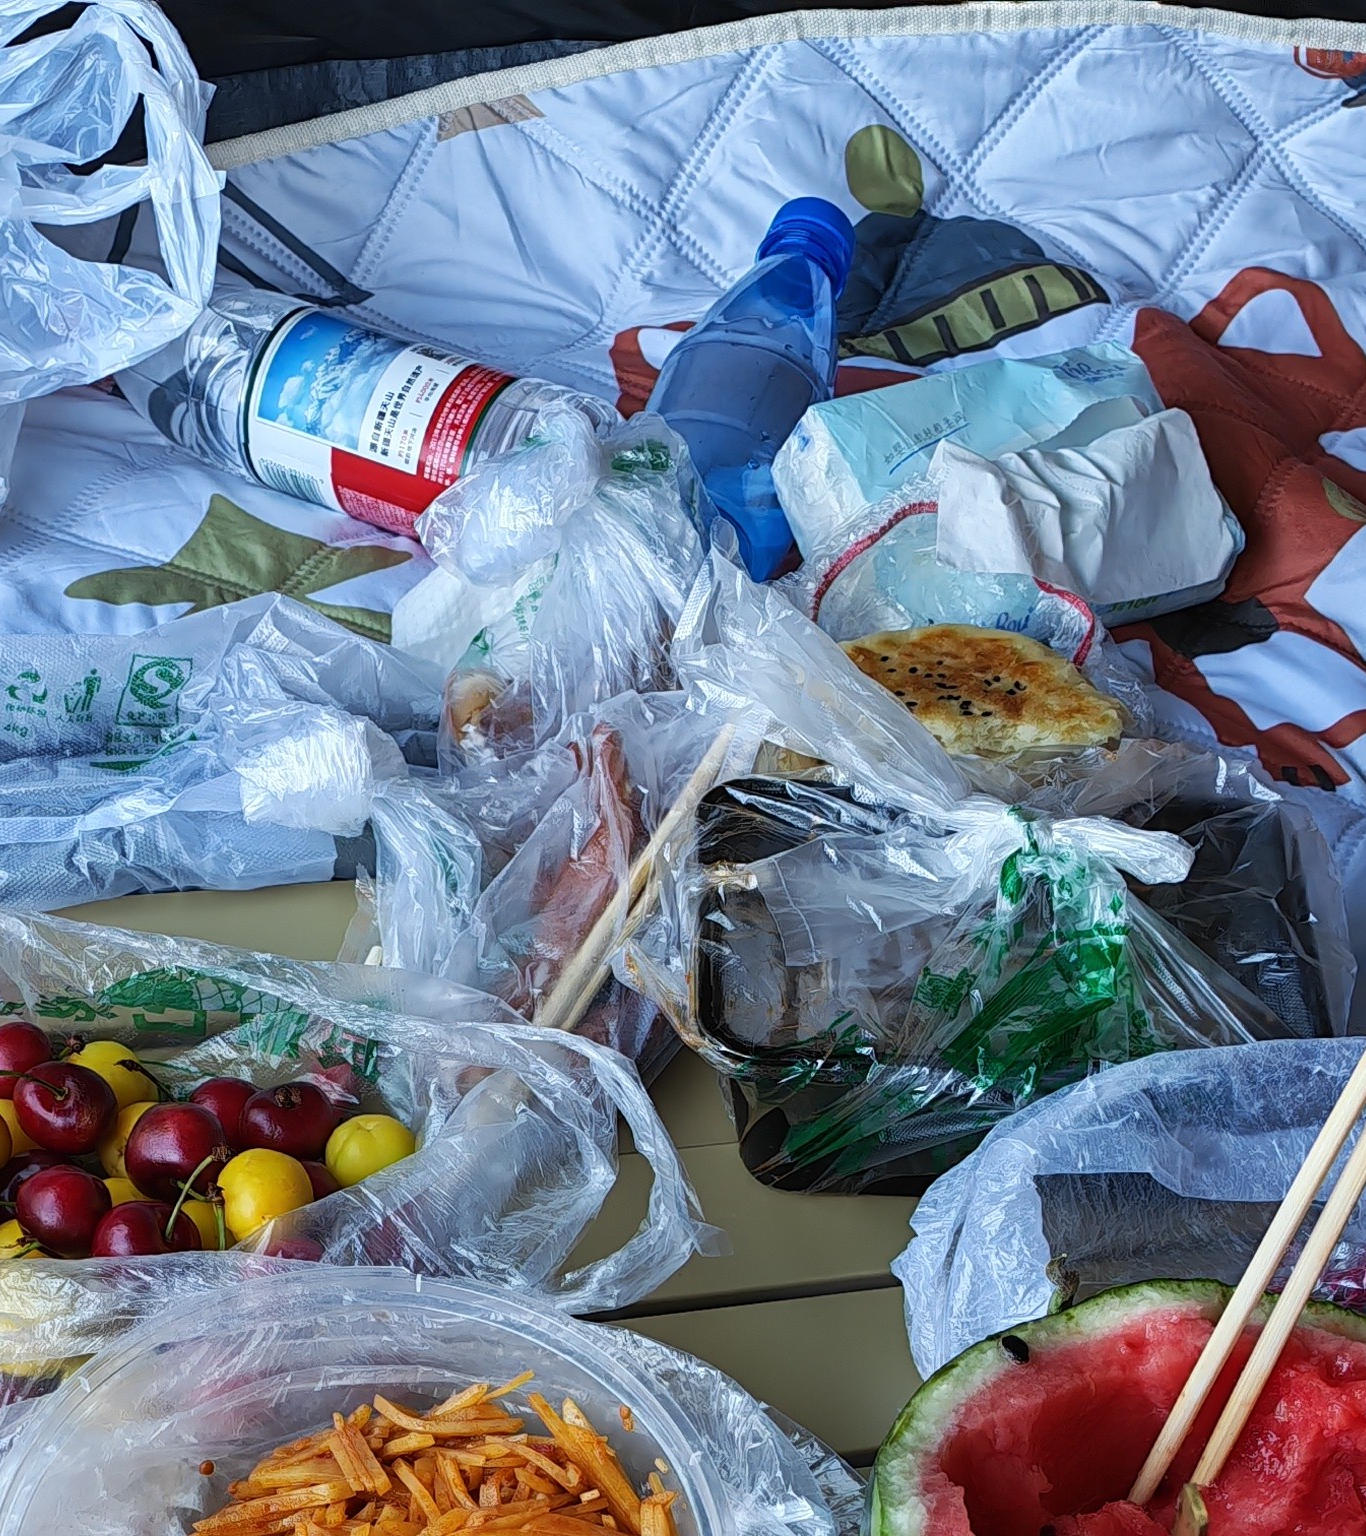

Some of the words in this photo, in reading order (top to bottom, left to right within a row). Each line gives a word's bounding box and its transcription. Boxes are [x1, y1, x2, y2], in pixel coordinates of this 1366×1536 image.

[371, 391, 395, 453] 源自新疆天山
[380, 364, 423, 458] 新疆天山是世界自然遗产
